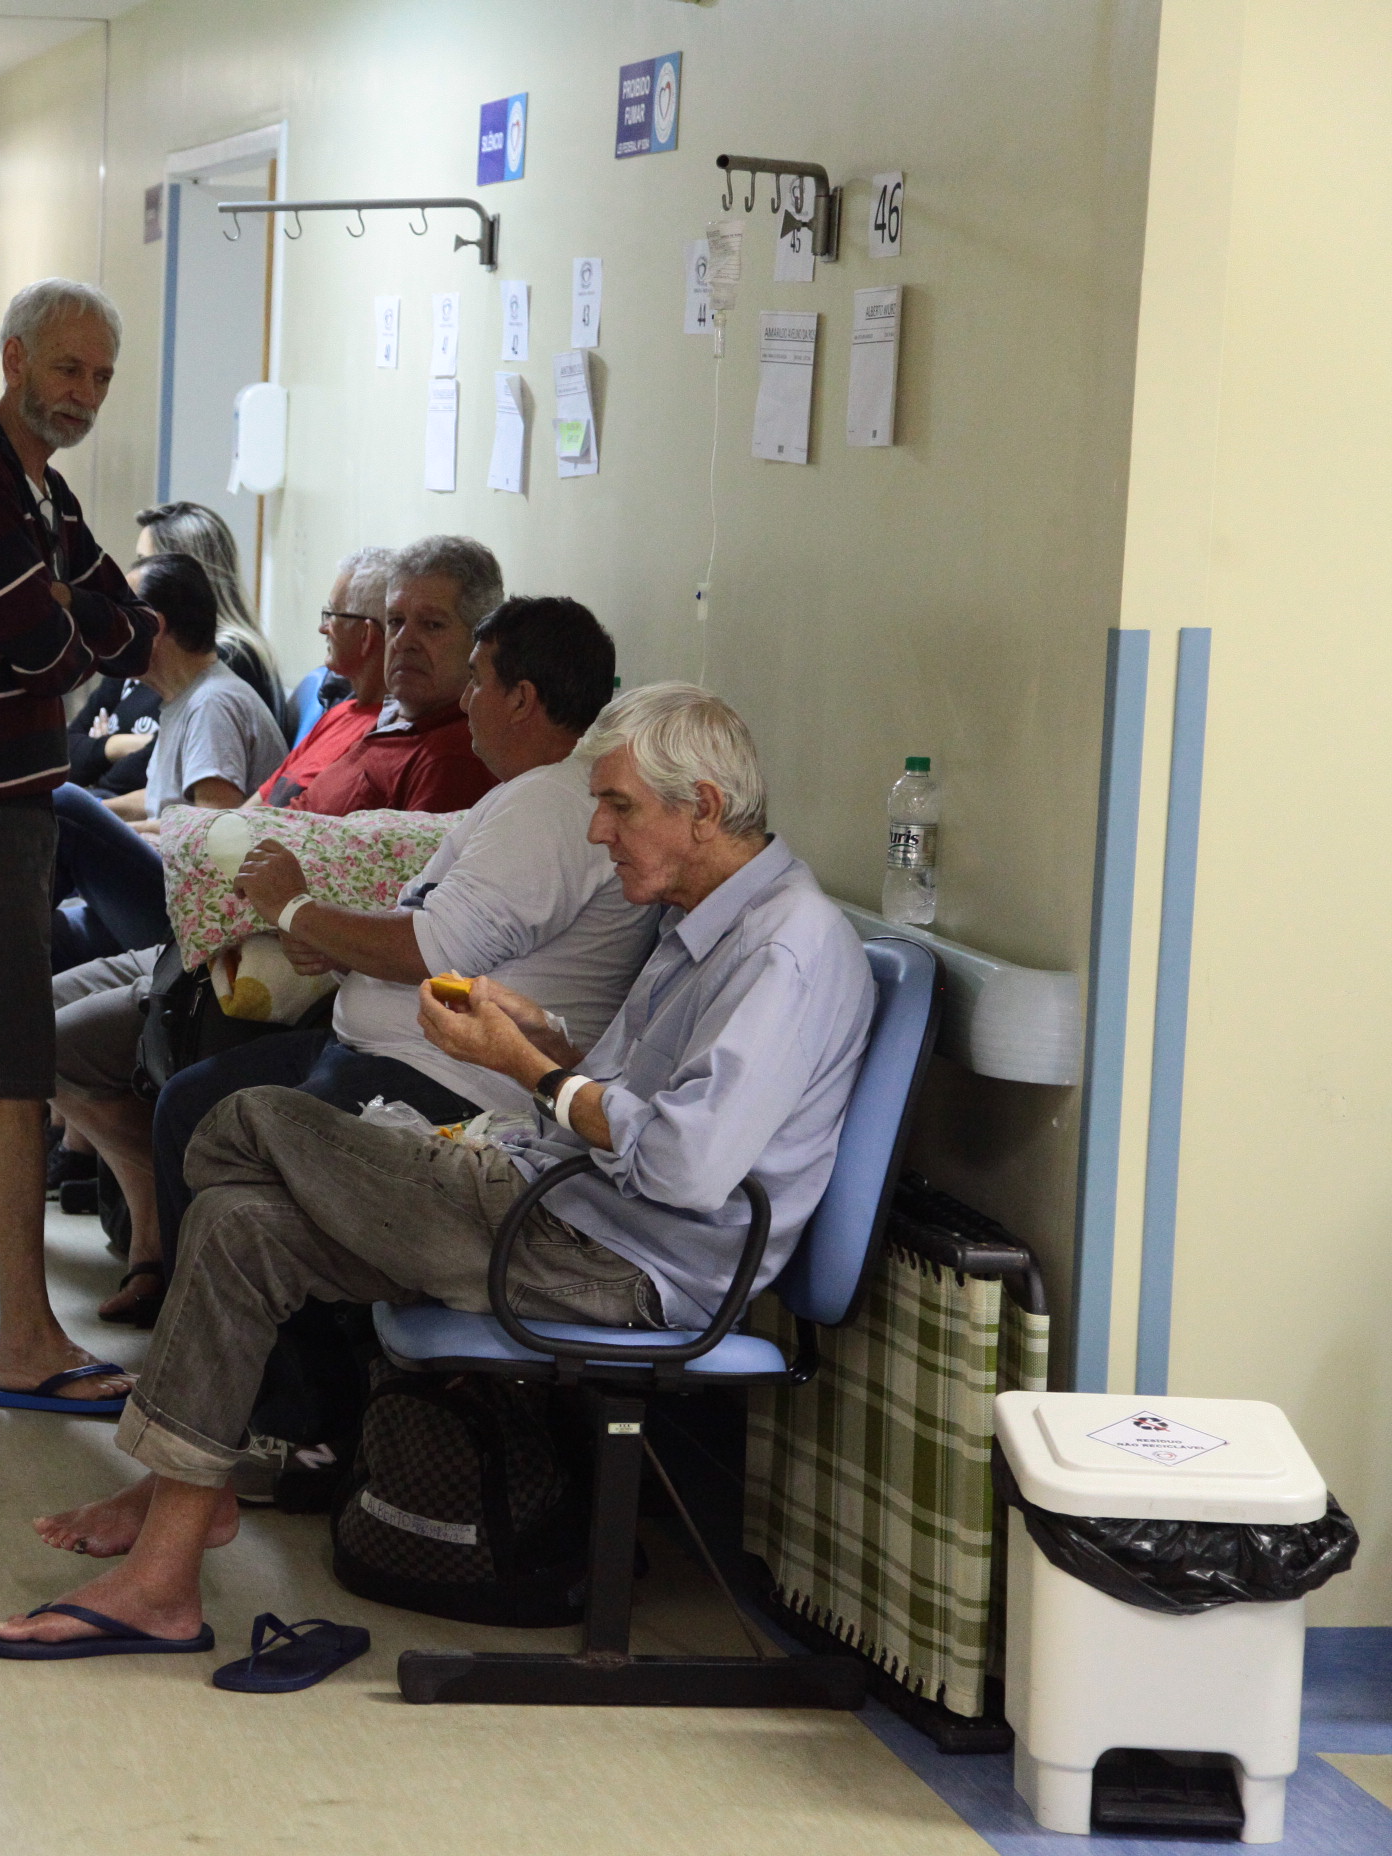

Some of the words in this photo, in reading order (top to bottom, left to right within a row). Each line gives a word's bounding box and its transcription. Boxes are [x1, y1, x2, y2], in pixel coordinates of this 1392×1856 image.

[622, 75, 651, 99] PROIBIDO
[624, 103, 646, 125] FUMAR
[874, 181, 902, 243] 46
[697, 303, 706, 327] 44
